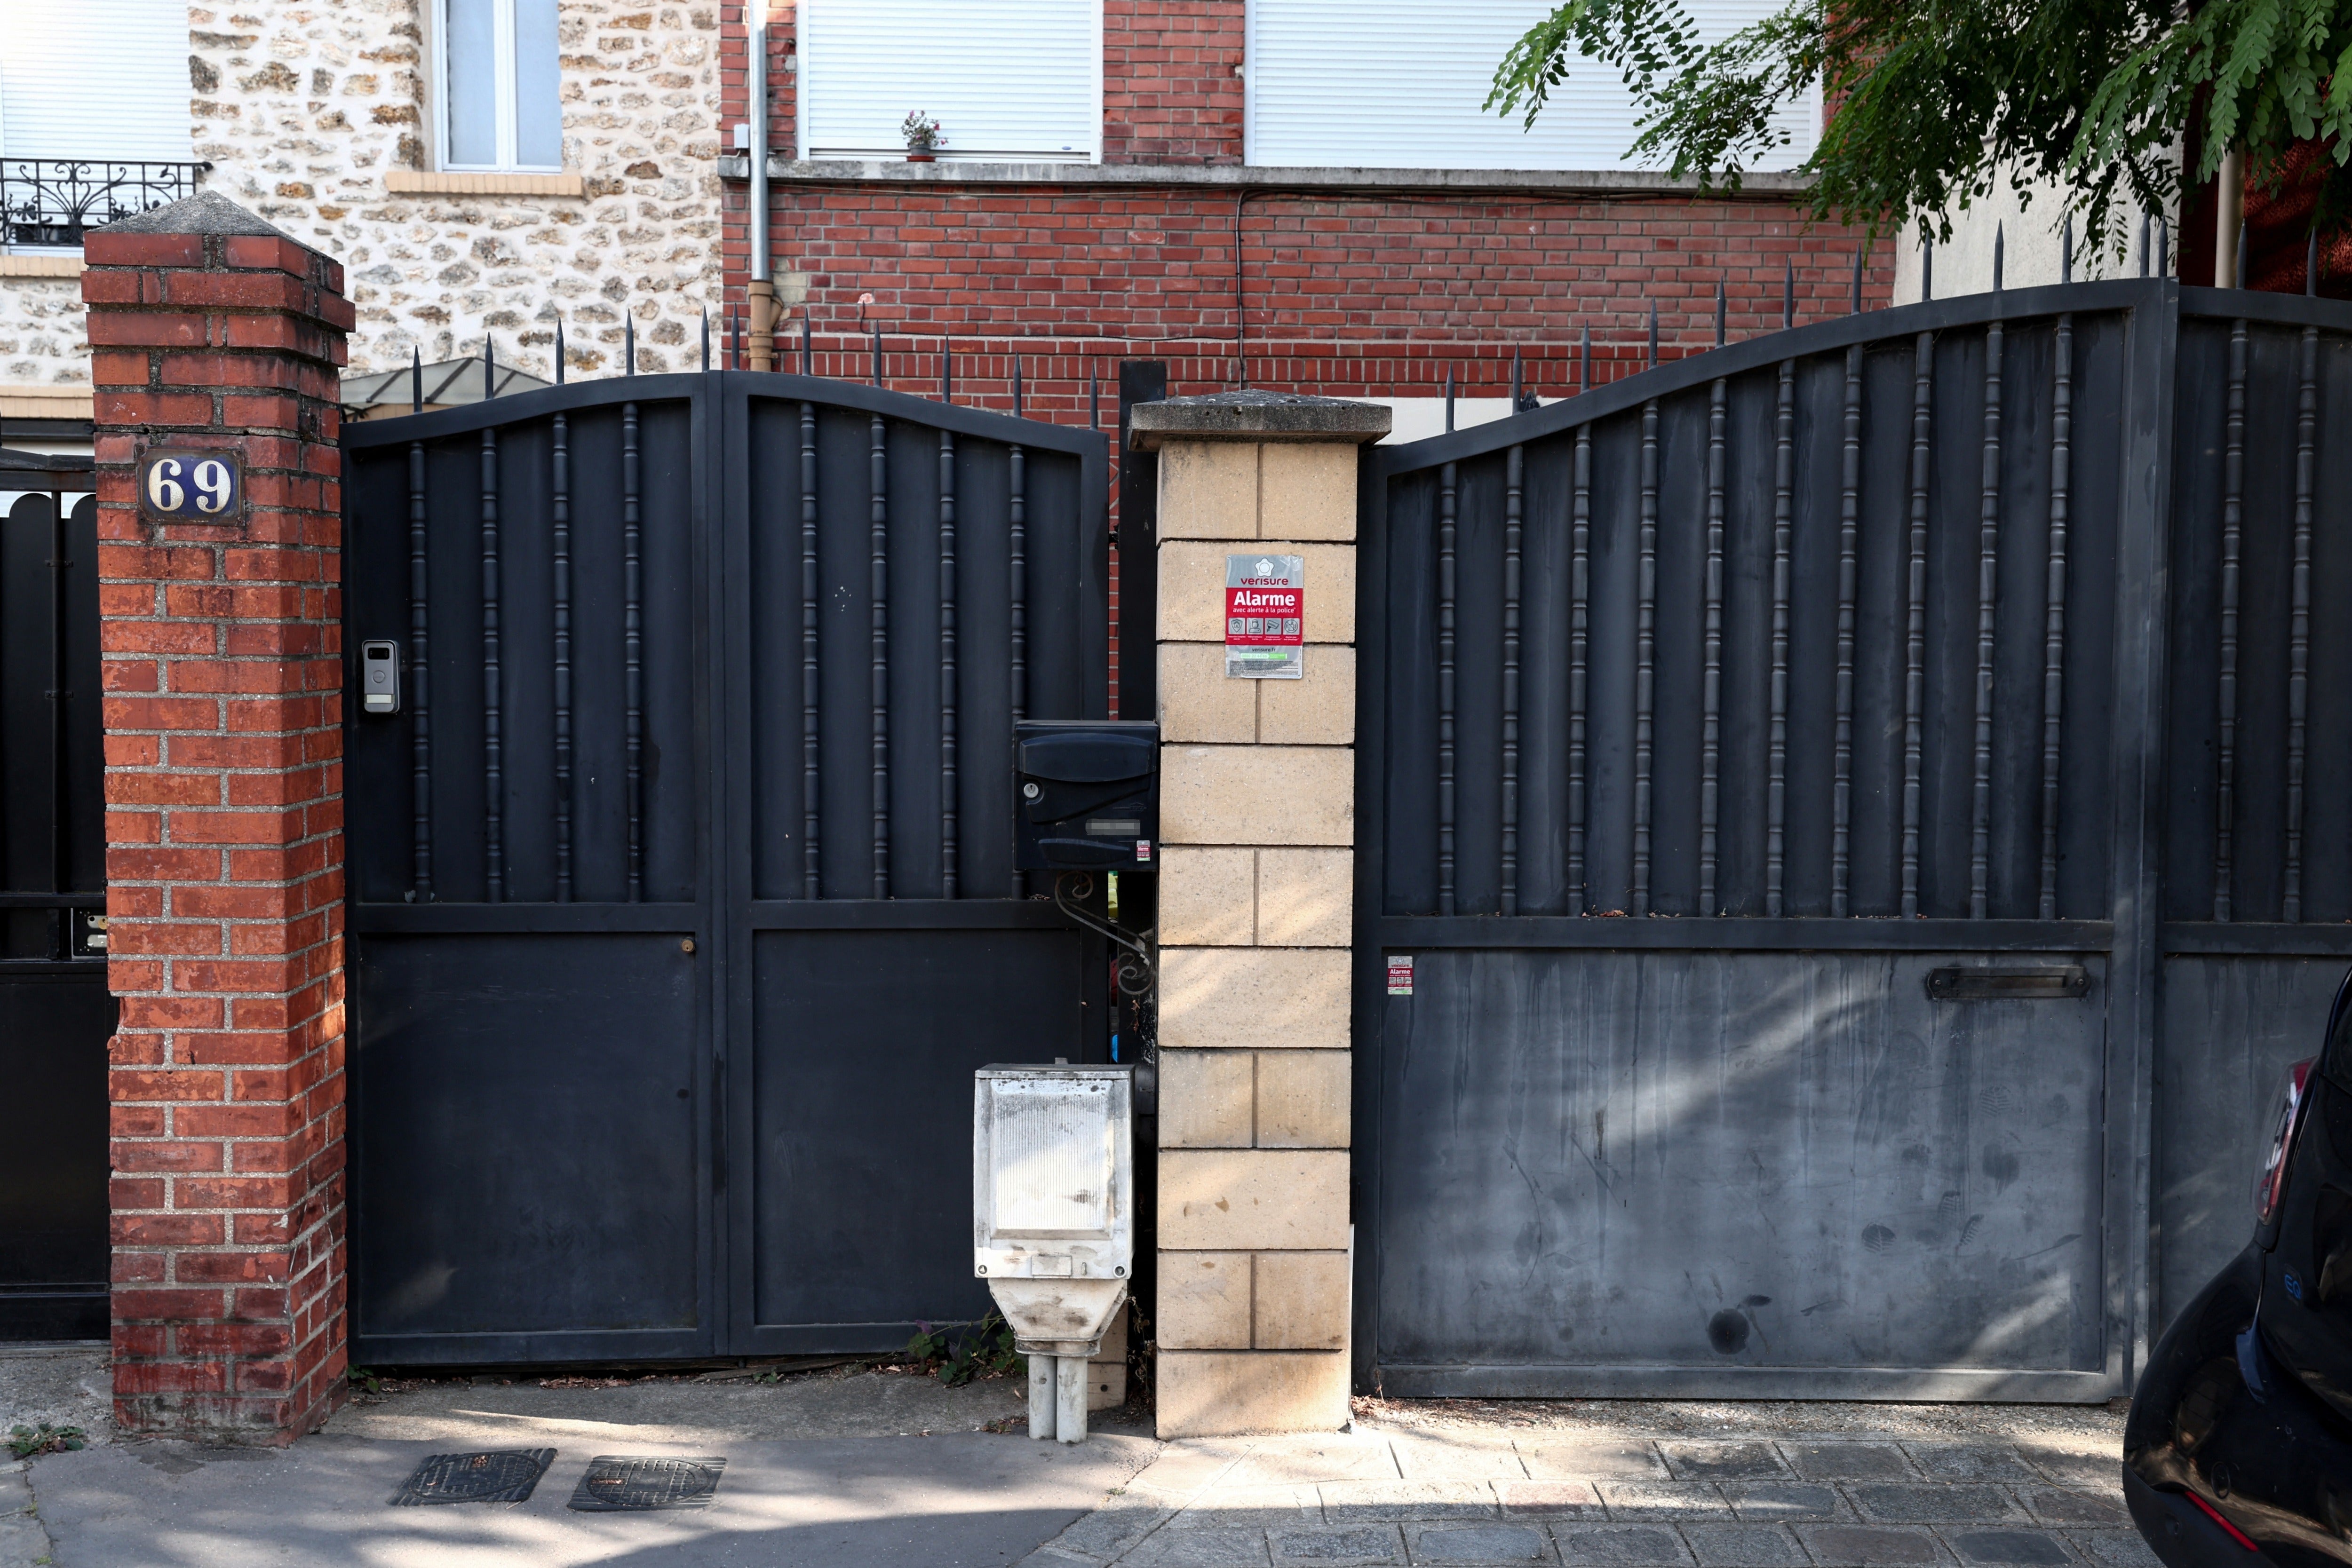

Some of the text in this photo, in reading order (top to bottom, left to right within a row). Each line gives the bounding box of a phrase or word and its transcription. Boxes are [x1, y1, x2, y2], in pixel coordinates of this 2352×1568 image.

[148, 458, 231, 513] 69
[1234, 590, 1295, 606] Alarme
[2285, 1274, 2301, 1299] EQ
